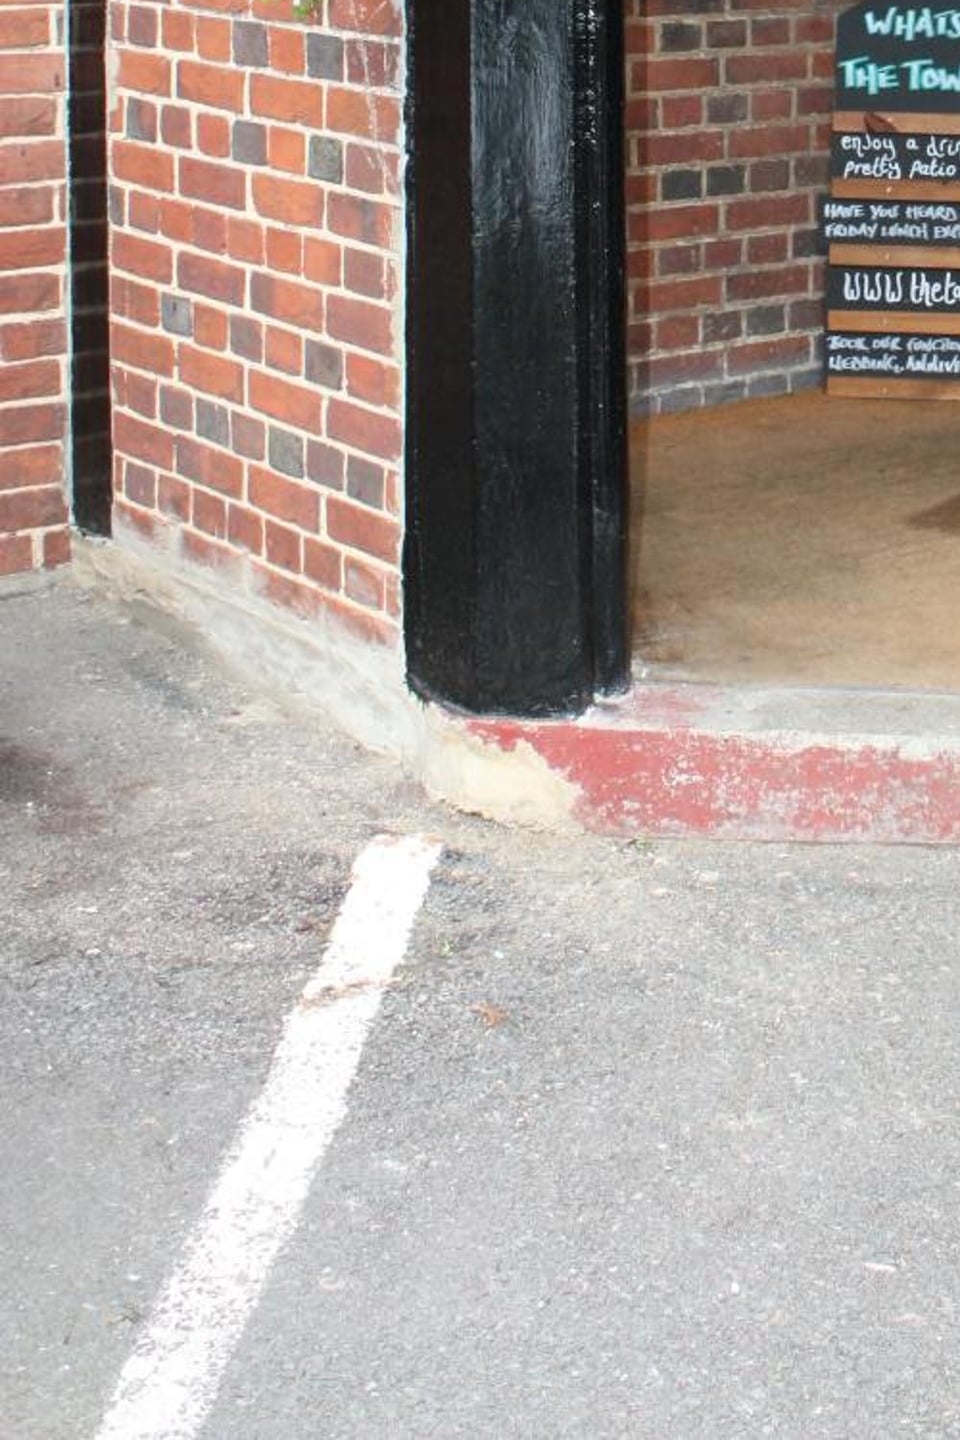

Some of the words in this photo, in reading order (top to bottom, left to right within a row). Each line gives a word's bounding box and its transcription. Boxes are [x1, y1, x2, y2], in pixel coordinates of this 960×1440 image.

[838, 56, 899, 95] THE
[905, 138, 919, 150] a
[843, 154, 901, 180] pretty
[824, 203, 865, 220] HAVE
[870, 204, 899, 220] YOU
[905, 206, 957, 221] HEARD
